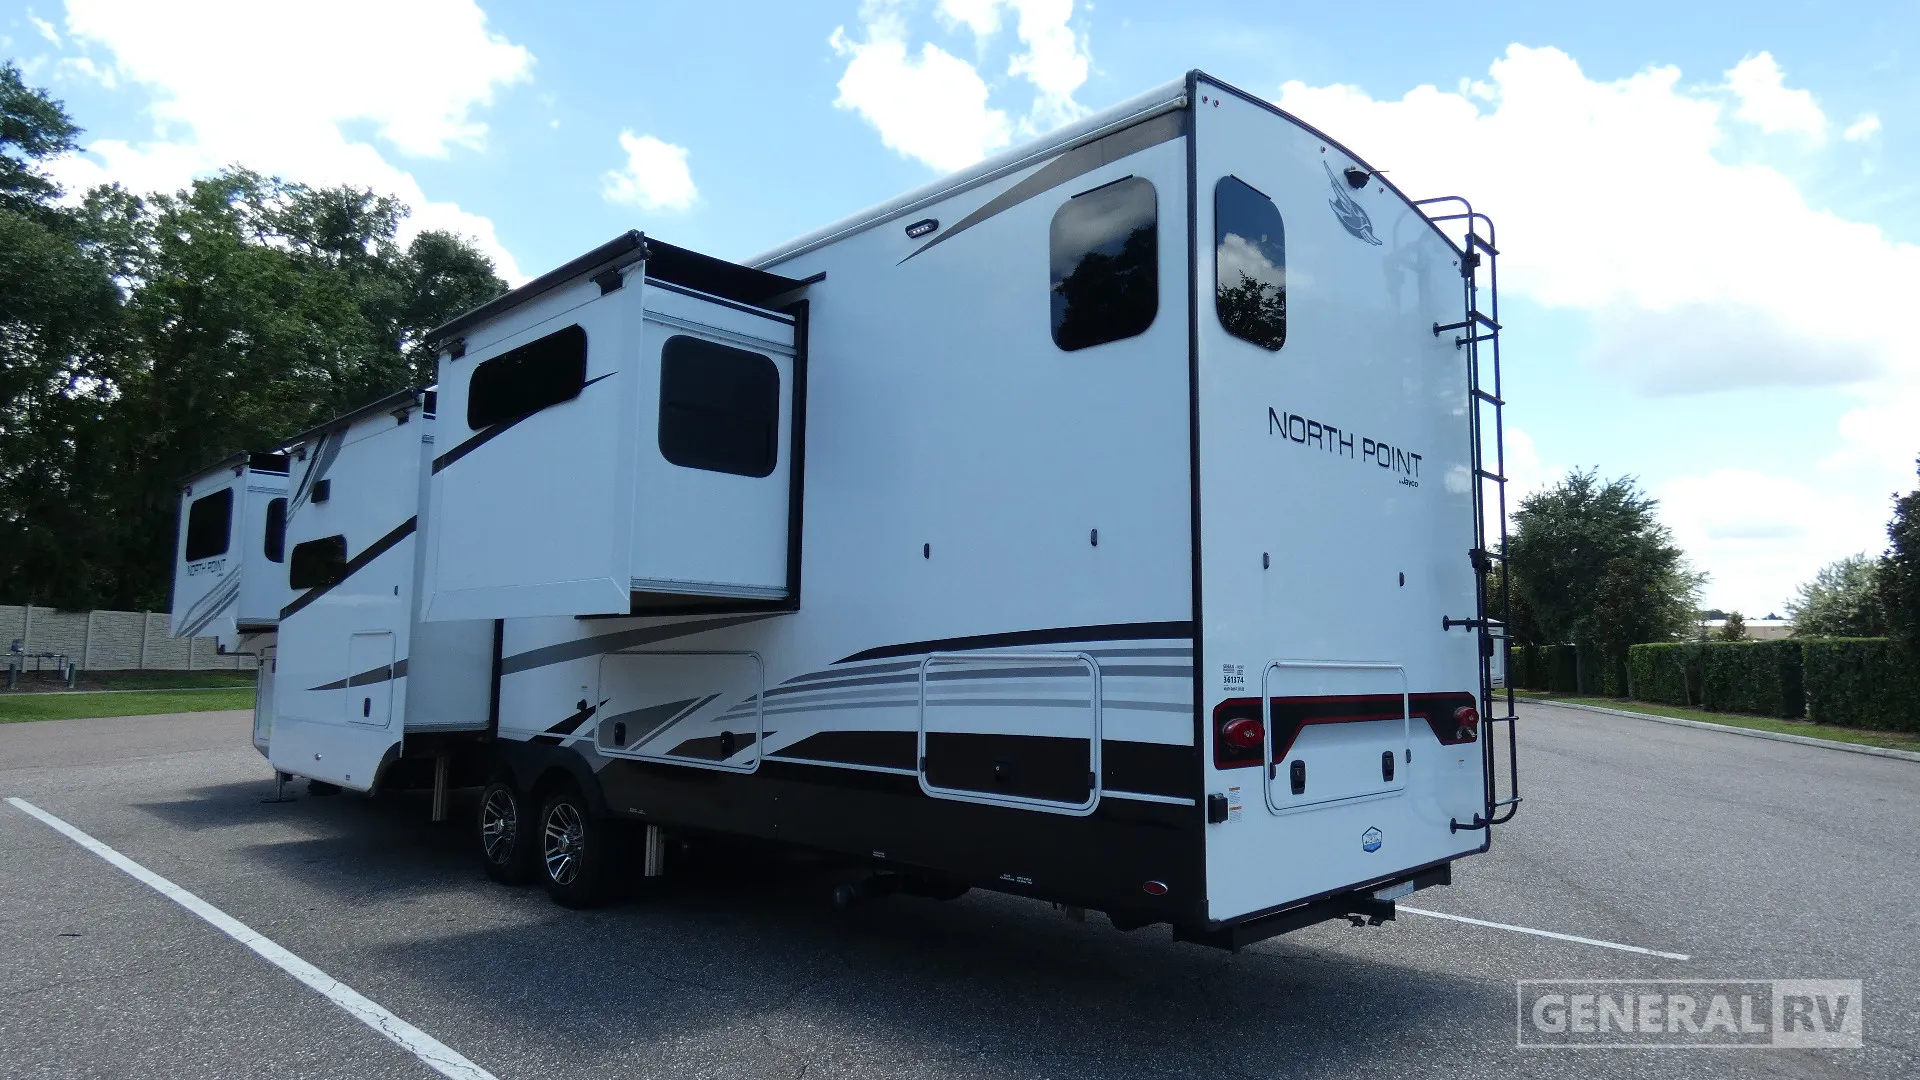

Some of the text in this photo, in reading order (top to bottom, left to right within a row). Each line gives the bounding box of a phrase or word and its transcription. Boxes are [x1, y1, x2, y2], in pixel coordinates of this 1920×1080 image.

[1268, 406, 1423, 477] NORTH POINT
[1401, 477, 1419, 487] Jayco
[187, 559, 226, 577] NORTH POINT
